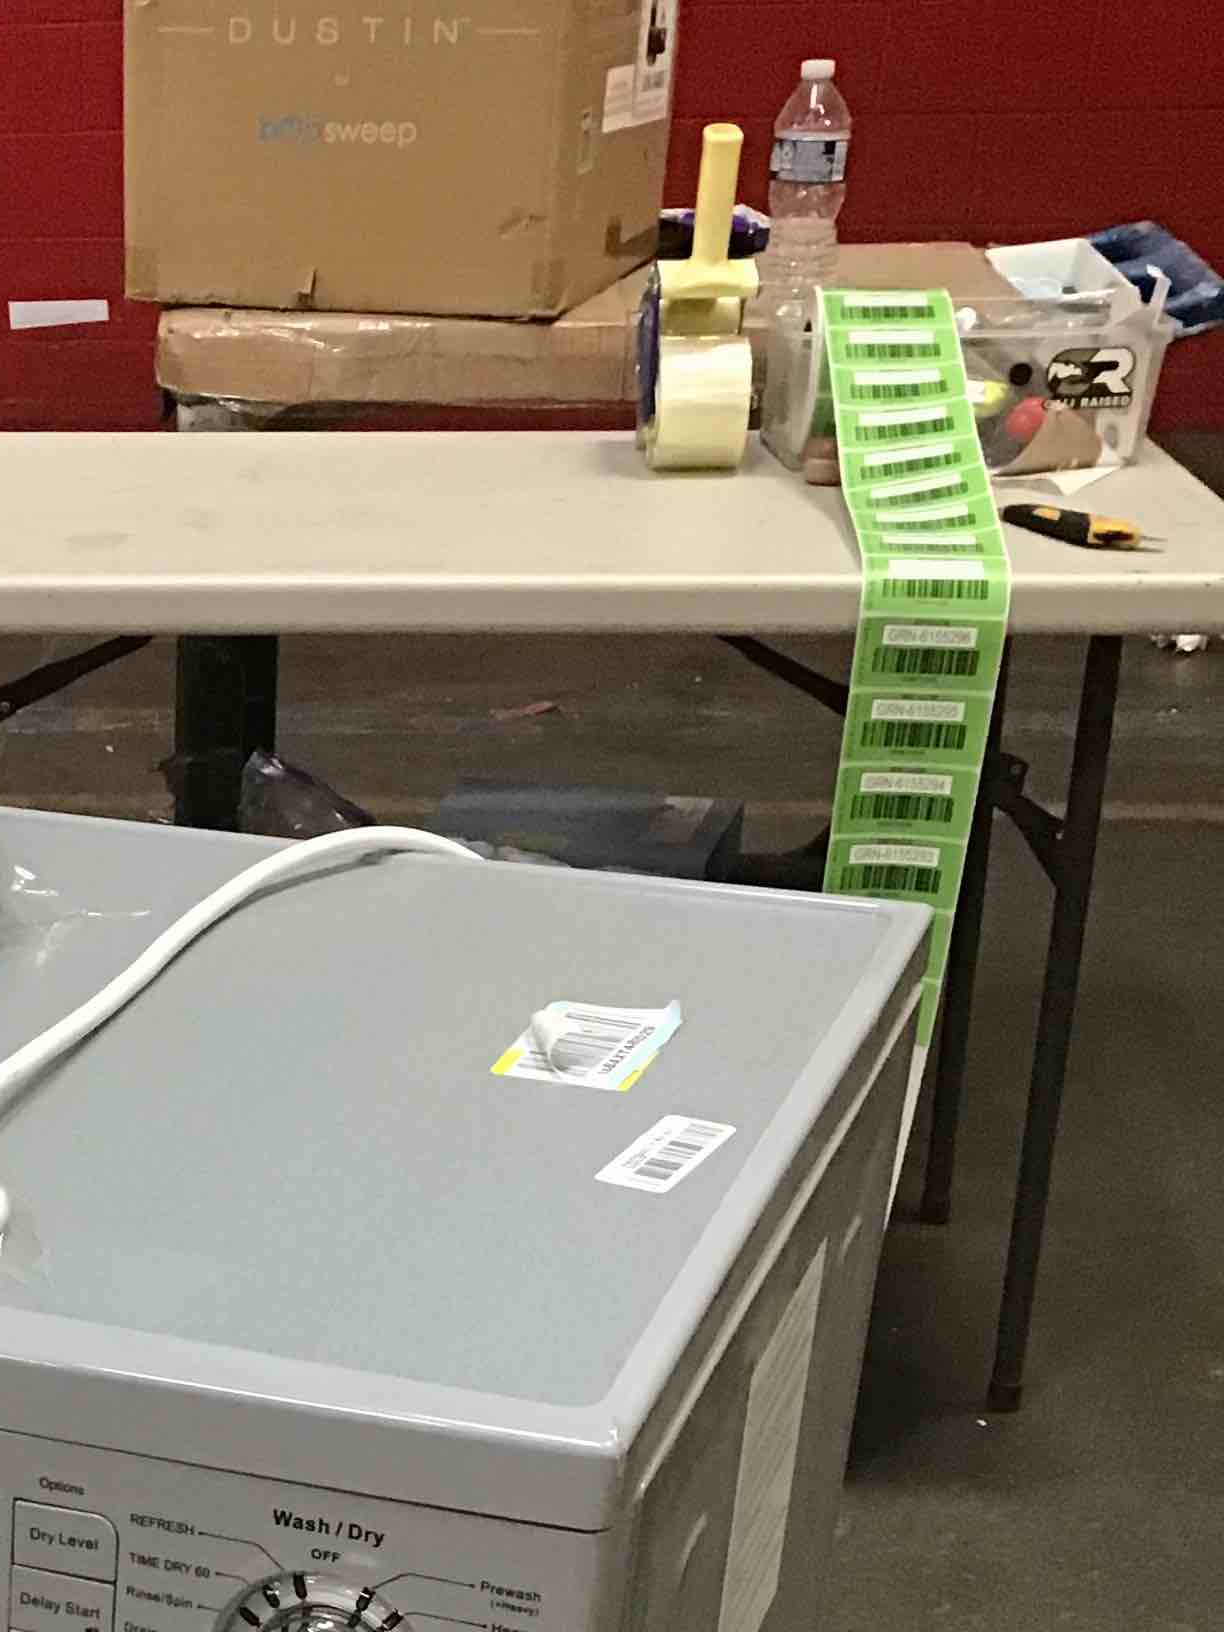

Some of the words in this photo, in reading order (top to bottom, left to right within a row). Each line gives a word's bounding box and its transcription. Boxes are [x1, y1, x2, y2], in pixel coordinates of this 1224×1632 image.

[228, 16, 460, 45] DUSTIN
[39, 1476, 85, 1495] Options
[130, 1512, 195, 1535] REFRESH
[273, 1508, 330, 1535] Wash
[348, 1523, 385, 1548] Dry
[30, 1527, 55, 1545] Dry
[58, 1531, 99, 1550] Level
[128, 1551, 160, 1569] TIME
[164, 1559, 192, 1575] DRY
[310, 1548, 342, 1563] OFF
[480, 1580, 541, 1602] Prewash
[19, 1591, 61, 1615] Delay
[65, 1600, 101, 1619] Start
